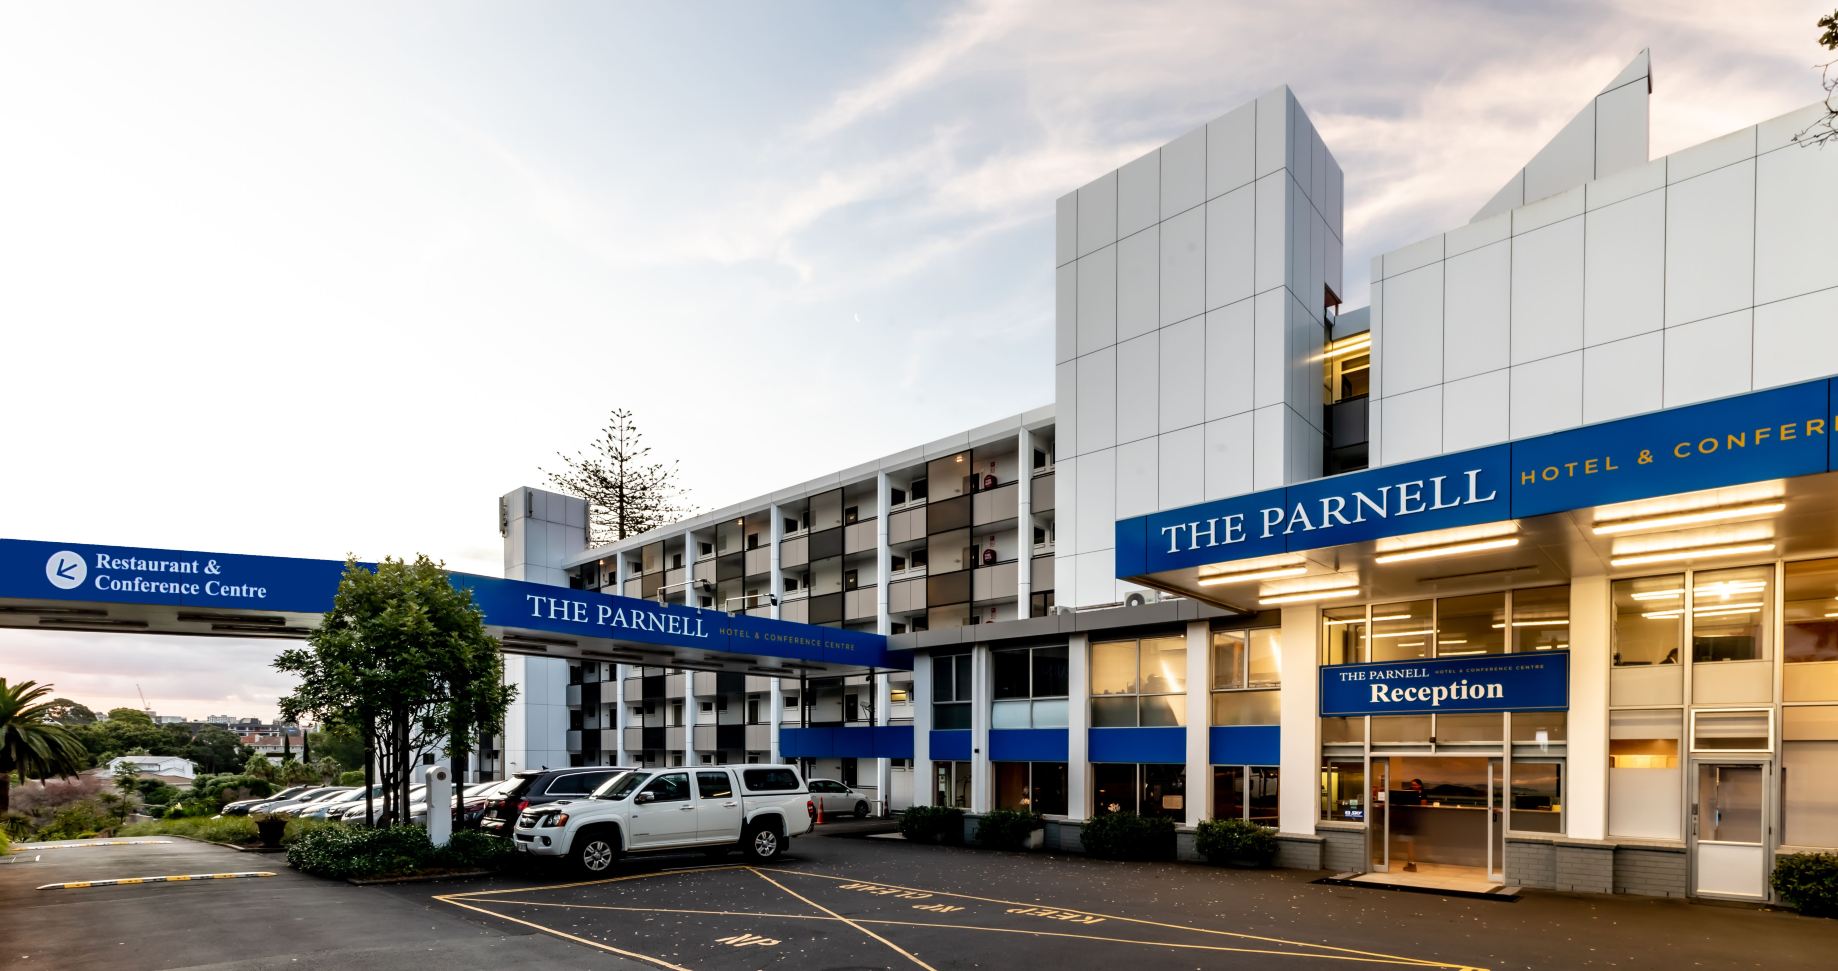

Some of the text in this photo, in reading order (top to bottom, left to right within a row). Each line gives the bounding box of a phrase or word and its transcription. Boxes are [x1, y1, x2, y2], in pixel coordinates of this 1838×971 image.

[1521, 414, 1838, 486] HOTEL & CONFER
[1162, 469, 1497, 554] THE PARNELL
[95, 553, 222, 575] Restaurant &
[95, 575, 267, 599] Conference Centre
[526, 594, 709, 638] THE PARNELL
[719, 627, 856, 651] HOTEL & CONFERENCE CENTRE
[1339, 668, 1430, 682] THE PARNELL
[1369, 679, 1505, 706] Reception
[839, 883, 1106, 924] KEEP CLEAR
